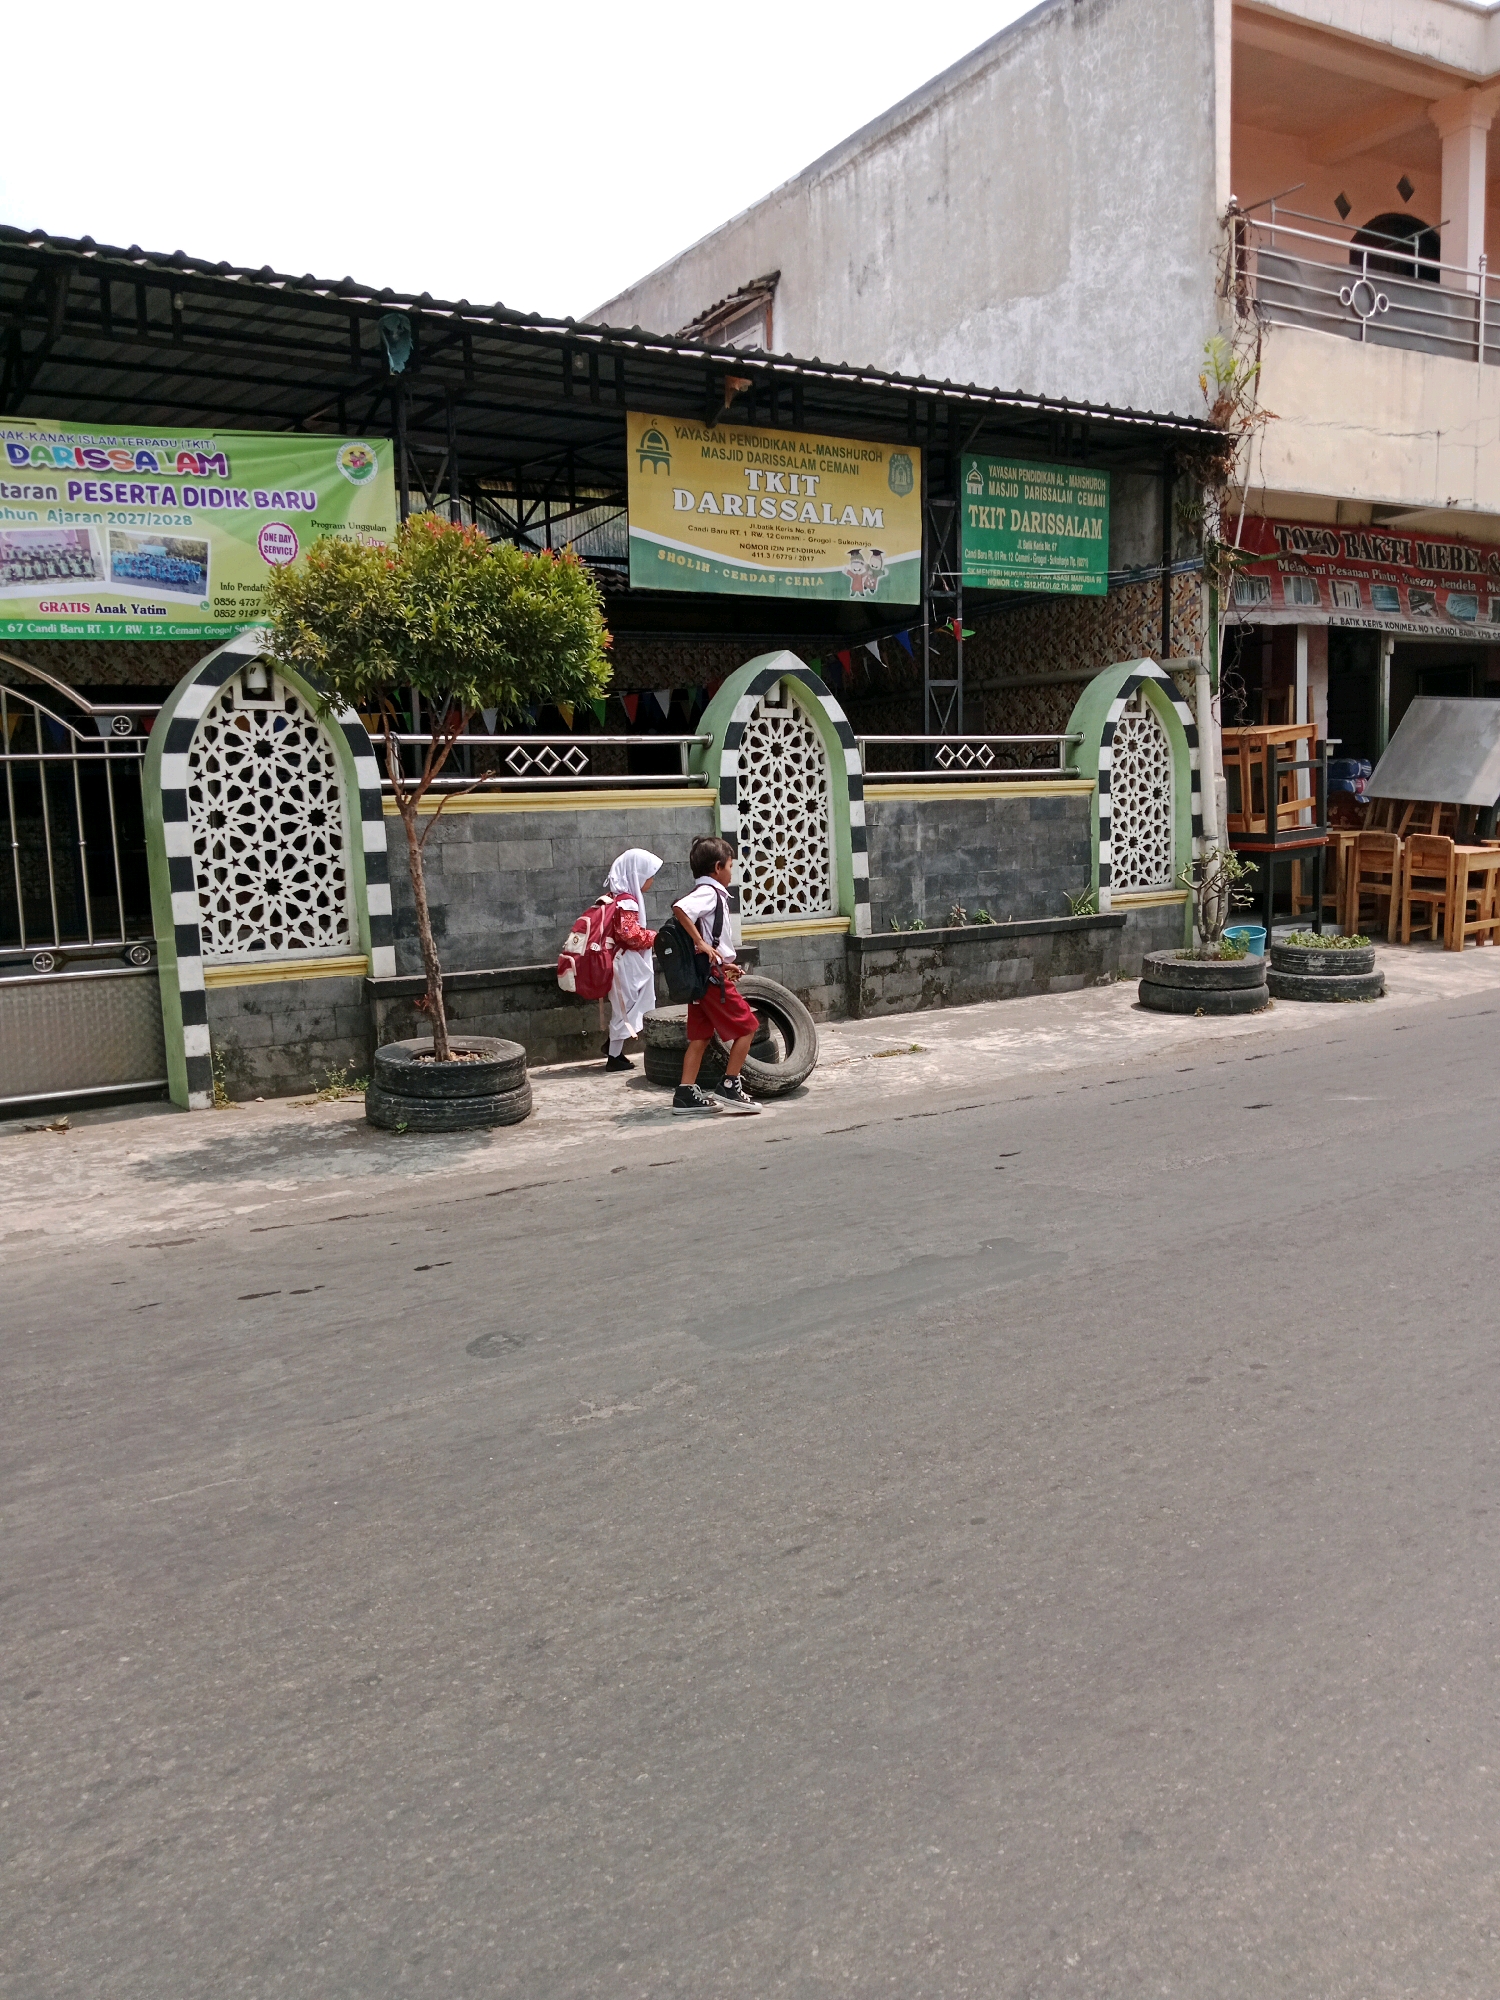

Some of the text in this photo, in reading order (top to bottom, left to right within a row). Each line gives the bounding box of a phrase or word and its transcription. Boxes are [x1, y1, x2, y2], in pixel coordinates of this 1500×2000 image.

[79, 435, 117, 446] ISLAM
[121, 438, 177, 448] TERPADU
[181, 440, 216, 450] (TKIT)
[674, 425, 883, 463] YAYASAN PENDIDIKAN AL-MANSHUROH
[5, 443, 228, 476] DARISSALAM
[701, 446, 859, 475] MASJID DARISSALAM CEMANI
[744, 468, 820, 497] TKIT
[988, 465, 1017, 480] YAYASAN
[1019, 468, 1055, 485] PENDIDIKAN
[1056, 474, 1064, 487] AL
[1069, 475, 1106, 491] MANSHUROH
[67, 481, 178, 506] PESERTA
[182, 487, 250, 508] DIDIK
[253, 491, 316, 511] BARU
[988, 481, 1106, 508] MASJID DARISSALAM CEMANI
[672, 488, 886, 529] DARISSALAM
[47, 509, 103, 524] Ajaran
[107, 511, 193, 526] 2027/2028
[310, 520, 387, 532] Program Unggulan
[968, 504, 1103, 540] TKIT DARISSALAM
[263, 532, 292, 544] ONE DAY
[687, 525, 709, 533] Candi
[710, 527, 728, 535] Baru
[263, 545, 293, 556] SERVICE
[740, 543, 769, 551] NOMOR
[786, 546, 826, 555] PENDIRIAN
[1274, 525, 1340, 558] TOKO
[1340, 531, 1414, 569] BAKTI
[1415, 541, 1489, 575] MEBEL
[657, 549, 824, 587] SHOLIH CERDAS CERIA
[987, 578, 1010, 587] NOMOR
[1070, 574, 1096, 583] MANUSIA
[1328, 563, 1370, 579] Pesanan
[1440, 578, 1477, 591] Jendela
[220, 582, 235, 591] Info
[39, 601, 167, 615] GRATIS Anak Yatim
[238, 598, 261, 607] 4737
[214, 609, 237, 618] 0852
[238, 609, 260, 618] 9149
[7, 623, 24, 633] 67
[27, 623, 57, 633] Candi
[60, 624, 85, 634] Baru
[87, 624, 105, 634] RT.
[125, 625, 146, 635] RW.
[169, 625, 202, 635] Cemani
[1340, 617, 1361, 627] BATIK
[1384, 621, 1418, 632] KONIMEX
[1418, 624, 1429, 633] NO
[1435, 626, 1457, 636] CANDI
